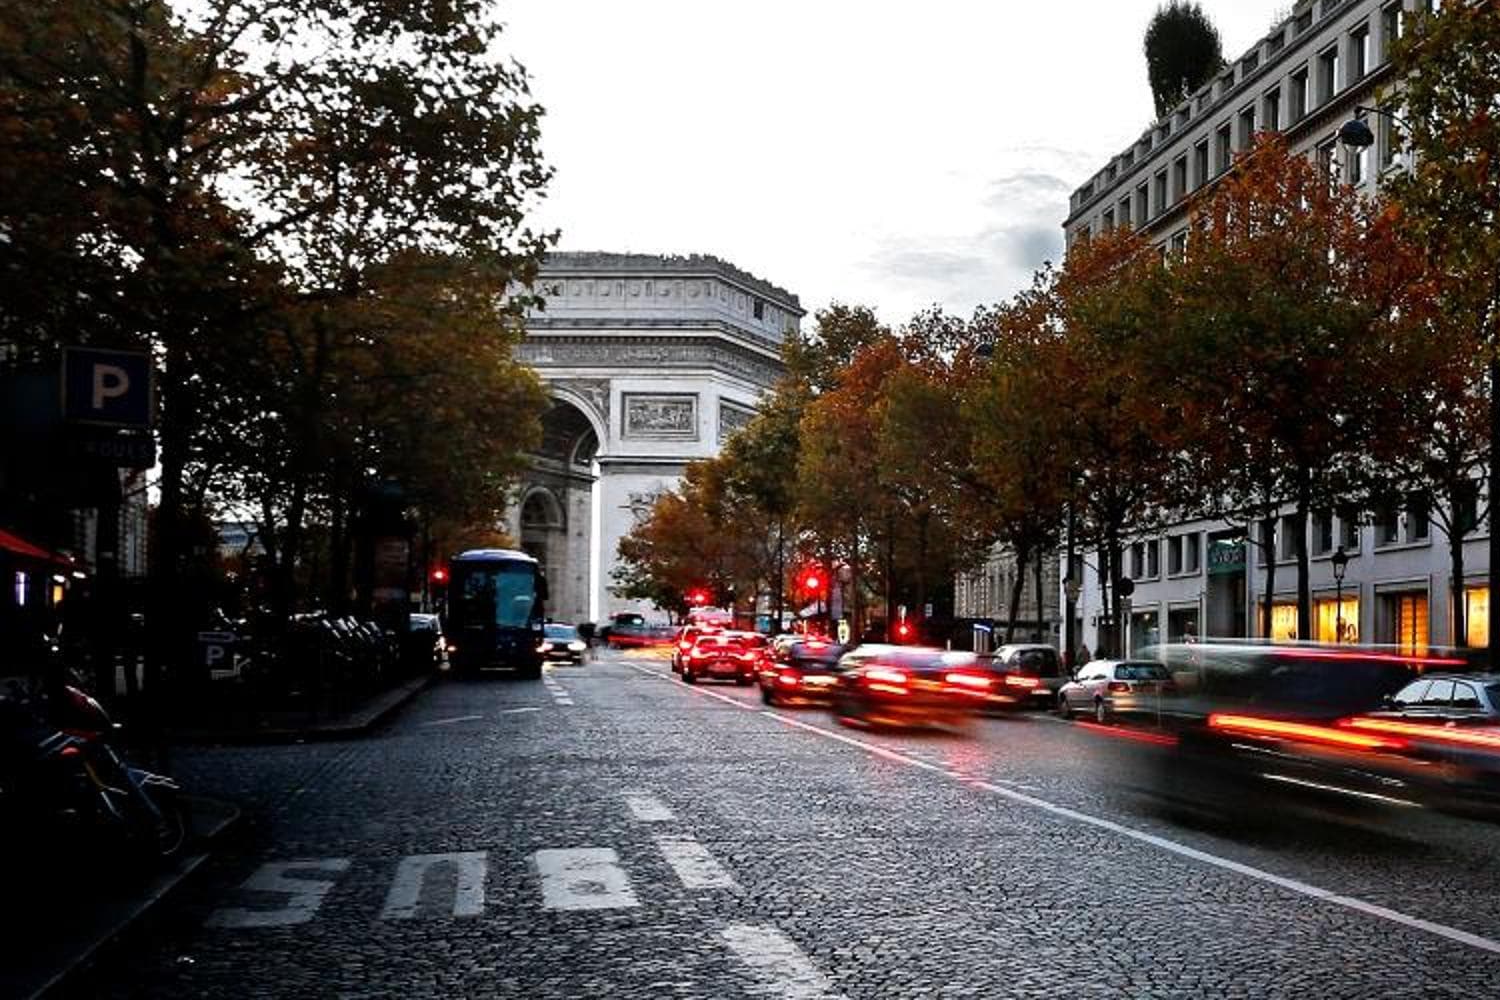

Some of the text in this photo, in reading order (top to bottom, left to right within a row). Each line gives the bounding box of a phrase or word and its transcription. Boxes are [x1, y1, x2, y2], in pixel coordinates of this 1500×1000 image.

[92, 362, 131, 409] P
[206, 645, 225, 666] P
[203, 846, 641, 928] BUS
